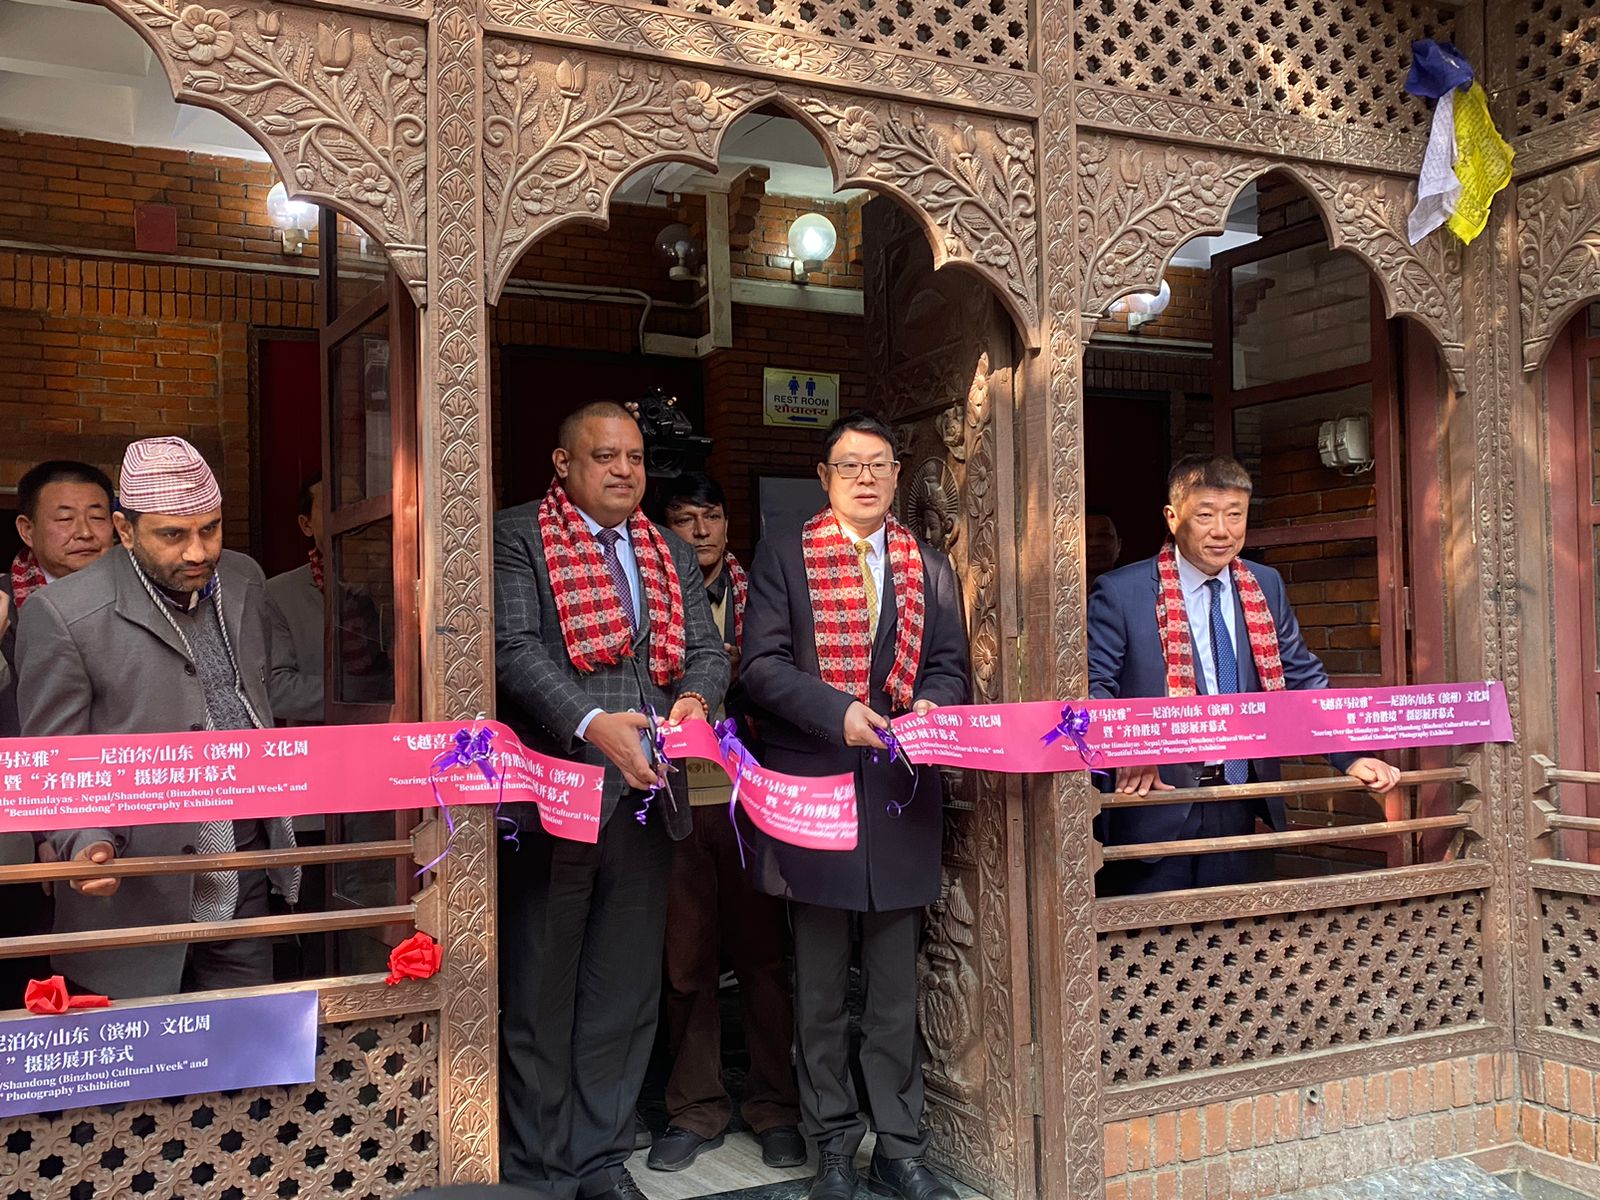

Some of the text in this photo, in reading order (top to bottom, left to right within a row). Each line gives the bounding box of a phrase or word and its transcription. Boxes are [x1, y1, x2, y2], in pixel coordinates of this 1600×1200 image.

[774, 395, 829, 406] REST ROOM
[450, 774, 464, 782] the
[18, 795, 73, 807] Himalayas
[165, 787, 214, 799] (Binzhou)
[215, 784, 255, 795] Cultural
[289, 782, 308, 792] and
[117, 799, 181, 812] Photography
[183, 797, 234, 808] Exhibition
[552, 807, 581, 820] Cultural
[58, 1069, 110, 1086] (Binzhou)
[111, 1064, 154, 1078] Cultural
[189, 1058, 208, 1068] and
[6, 1078, 130, 1102] Photography Exhibition
